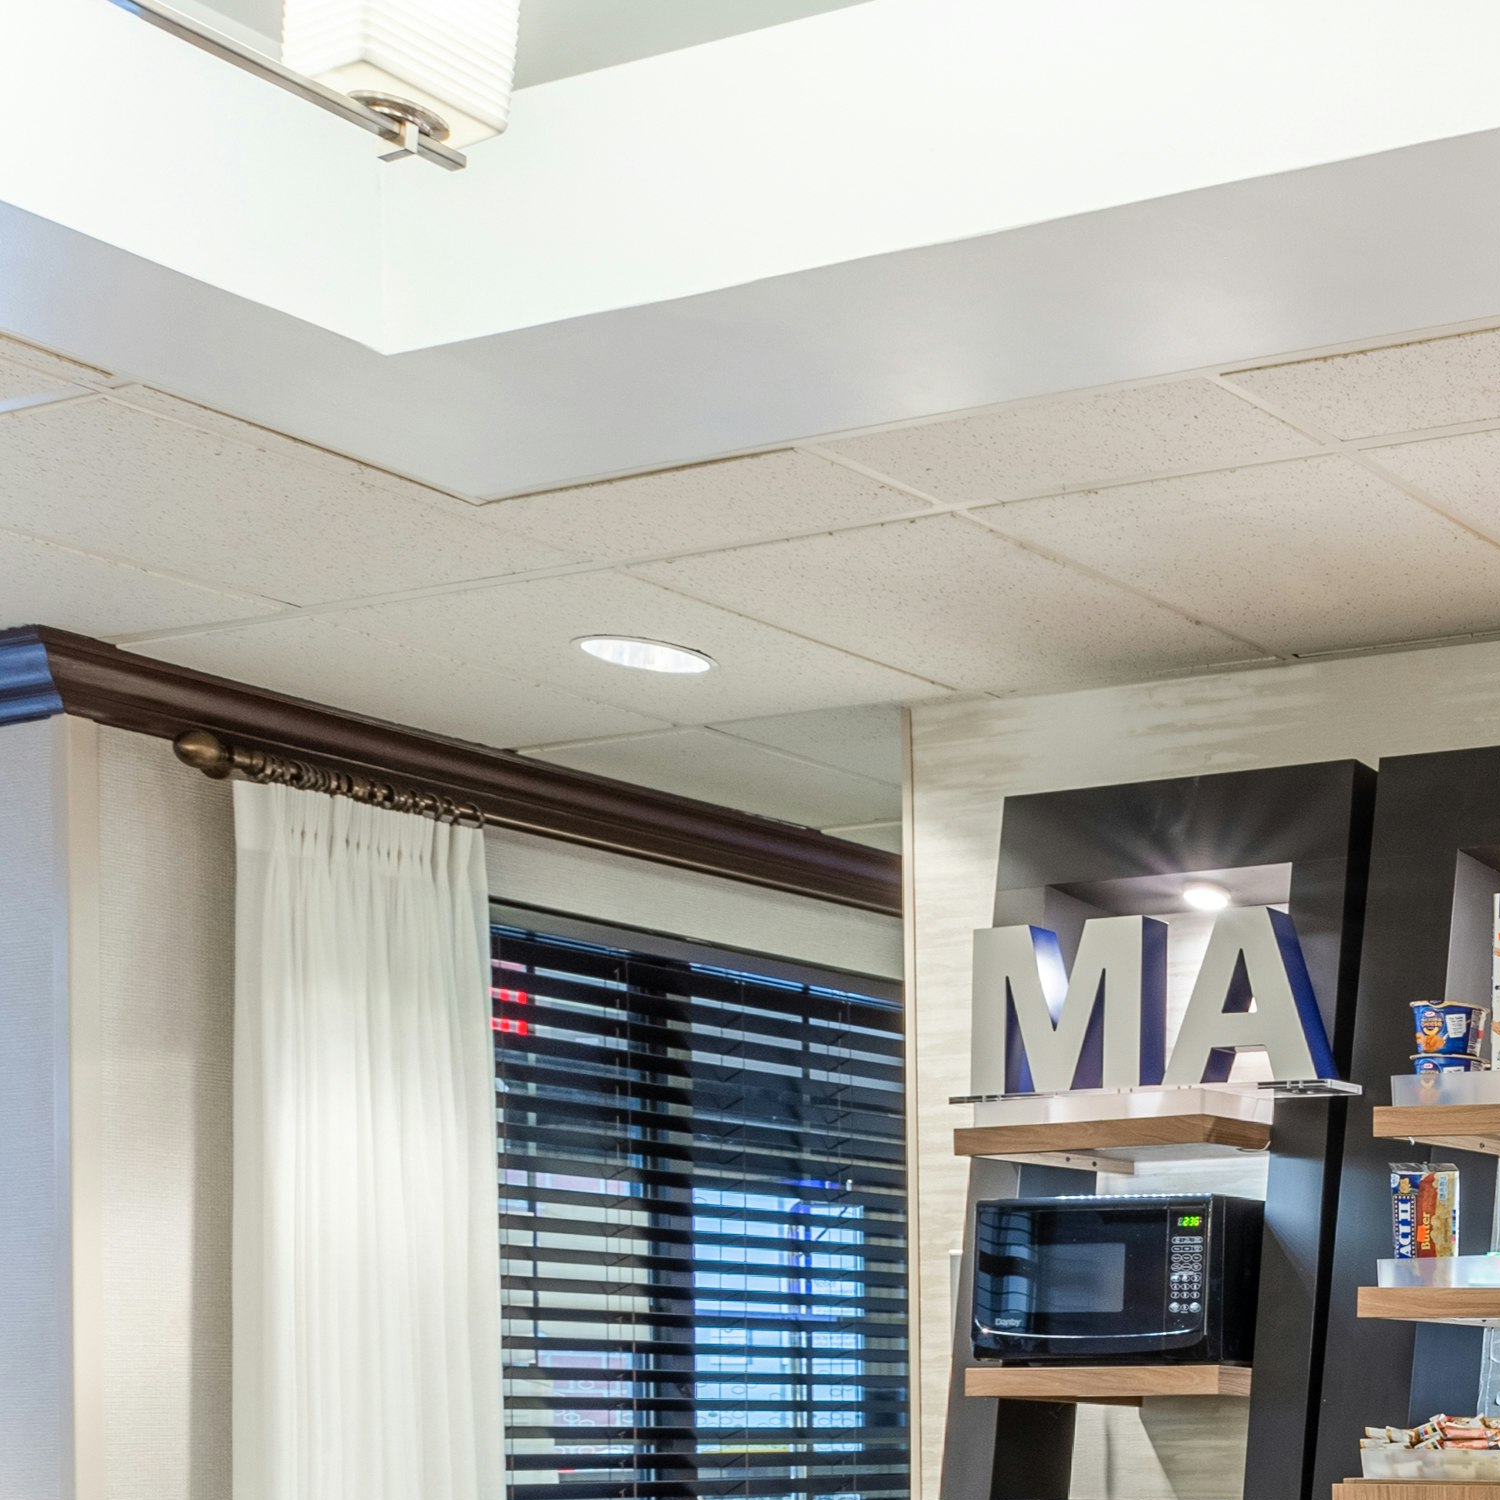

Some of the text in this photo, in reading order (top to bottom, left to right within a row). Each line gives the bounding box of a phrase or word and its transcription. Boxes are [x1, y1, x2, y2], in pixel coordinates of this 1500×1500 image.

[970, 906, 1332, 1096] MA
[1398, 1222, 1412, 1258] ACT
[1421, 1211, 1432, 1251] Butter
[995, 1317, 1023, 1328] Danby
